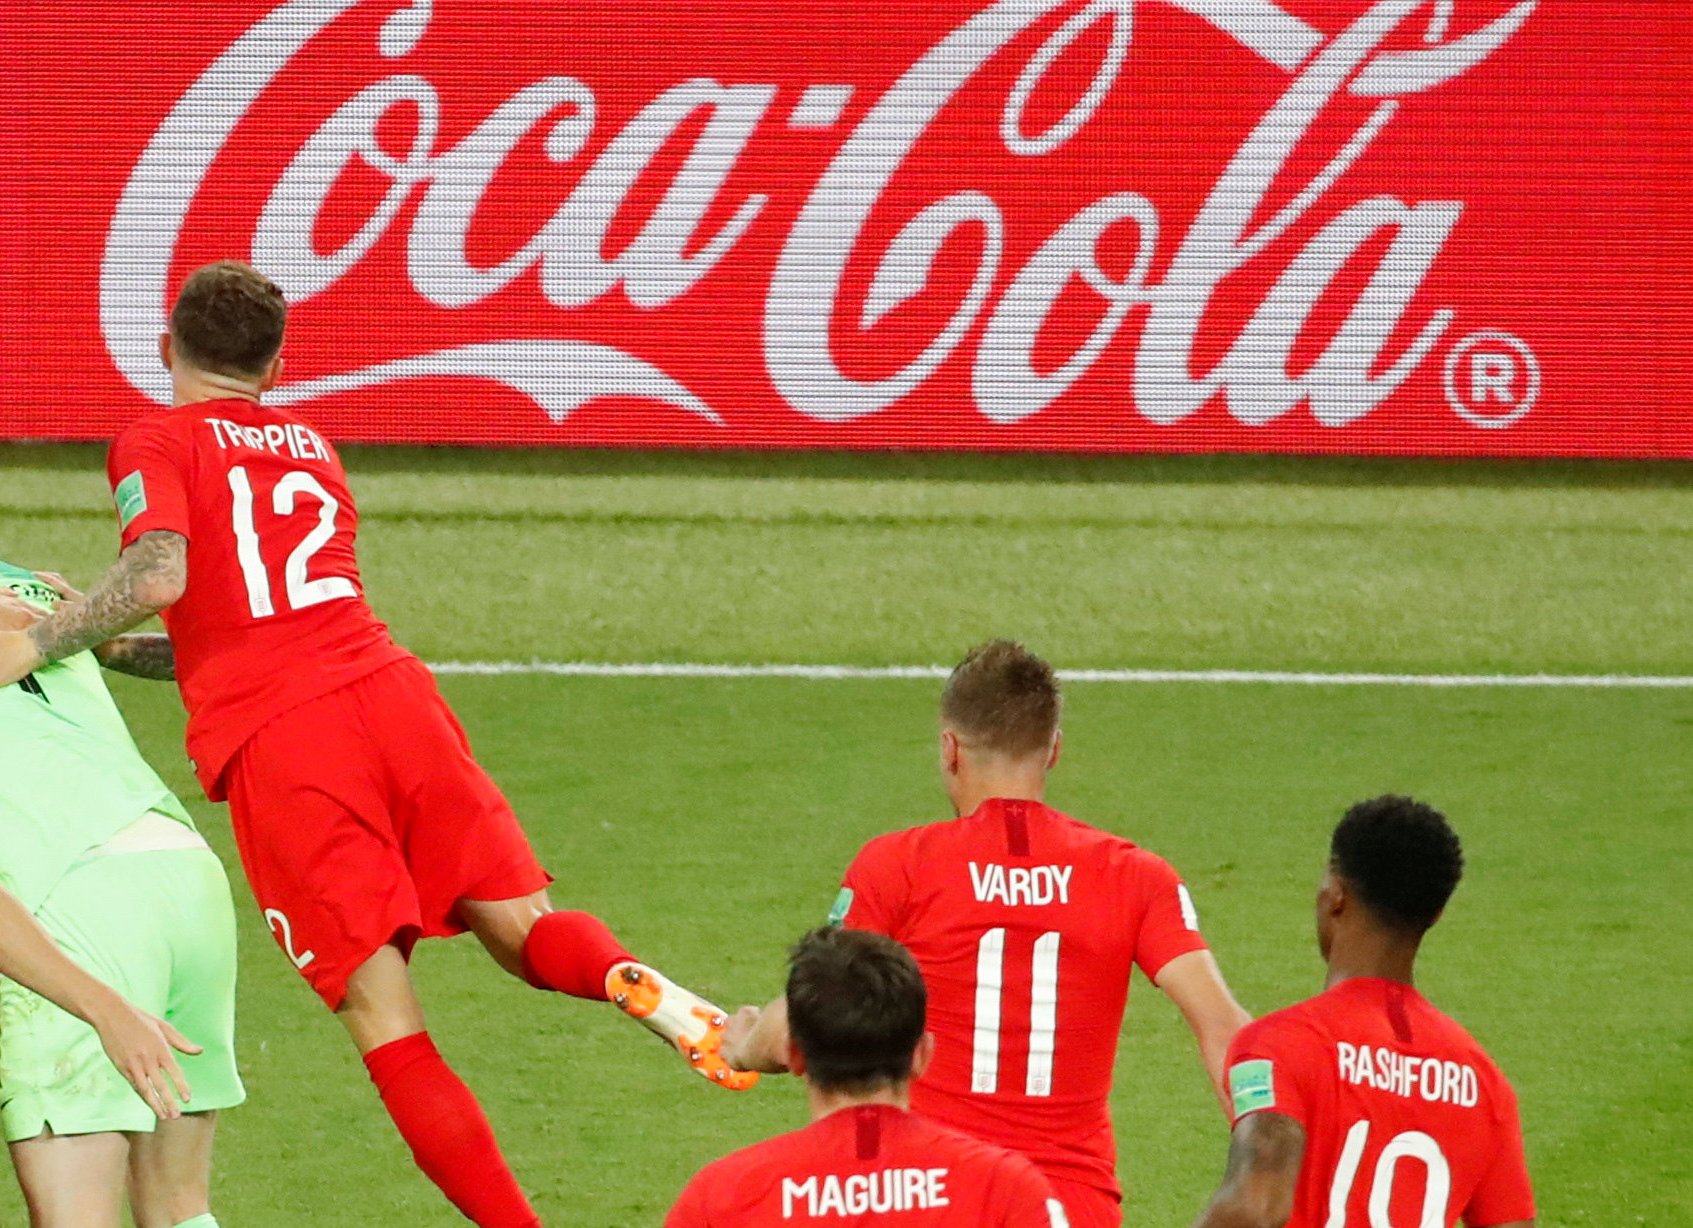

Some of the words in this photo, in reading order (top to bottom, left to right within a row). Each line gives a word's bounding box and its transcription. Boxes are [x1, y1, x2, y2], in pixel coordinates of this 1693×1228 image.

[98, 0, 1542, 428] Coca-Cola
[203, 417, 331, 463] TRIPPIER
[226, 465, 358, 619] 12
[968, 861, 1073, 906] VARDY
[970, 926, 1061, 1097] 11
[1337, 1041, 1480, 1109] RASHFORD
[781, 1167, 949, 1219] MAGUIRE
